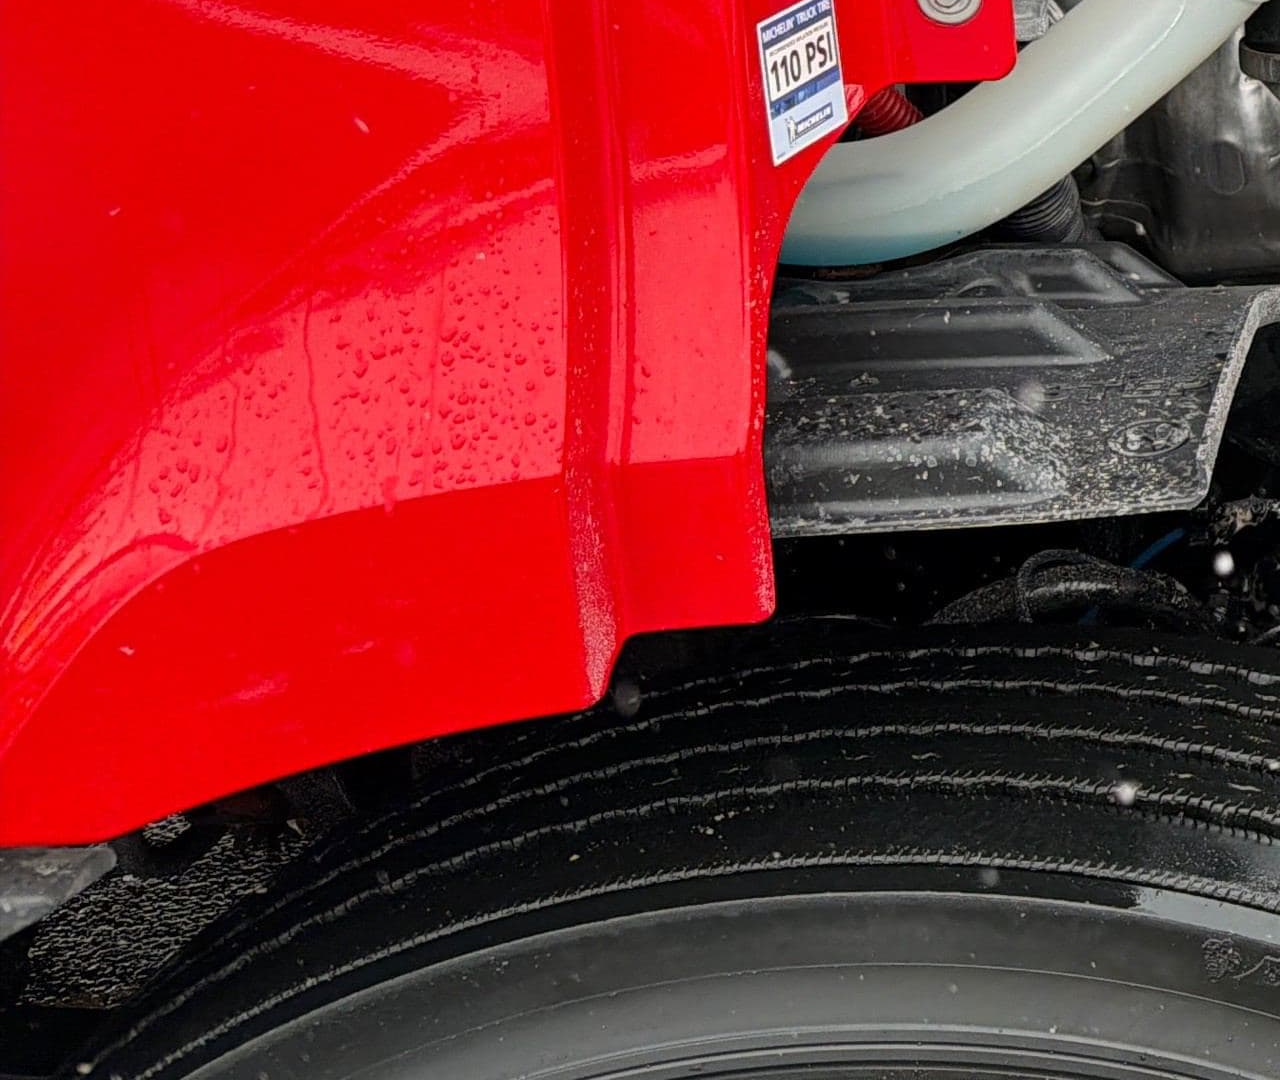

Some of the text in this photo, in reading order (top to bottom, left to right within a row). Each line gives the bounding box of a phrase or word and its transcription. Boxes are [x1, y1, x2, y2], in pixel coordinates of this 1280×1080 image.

[796, 5, 818, 25] TRUCK
[770, 31, 834, 93] 110 PSI
